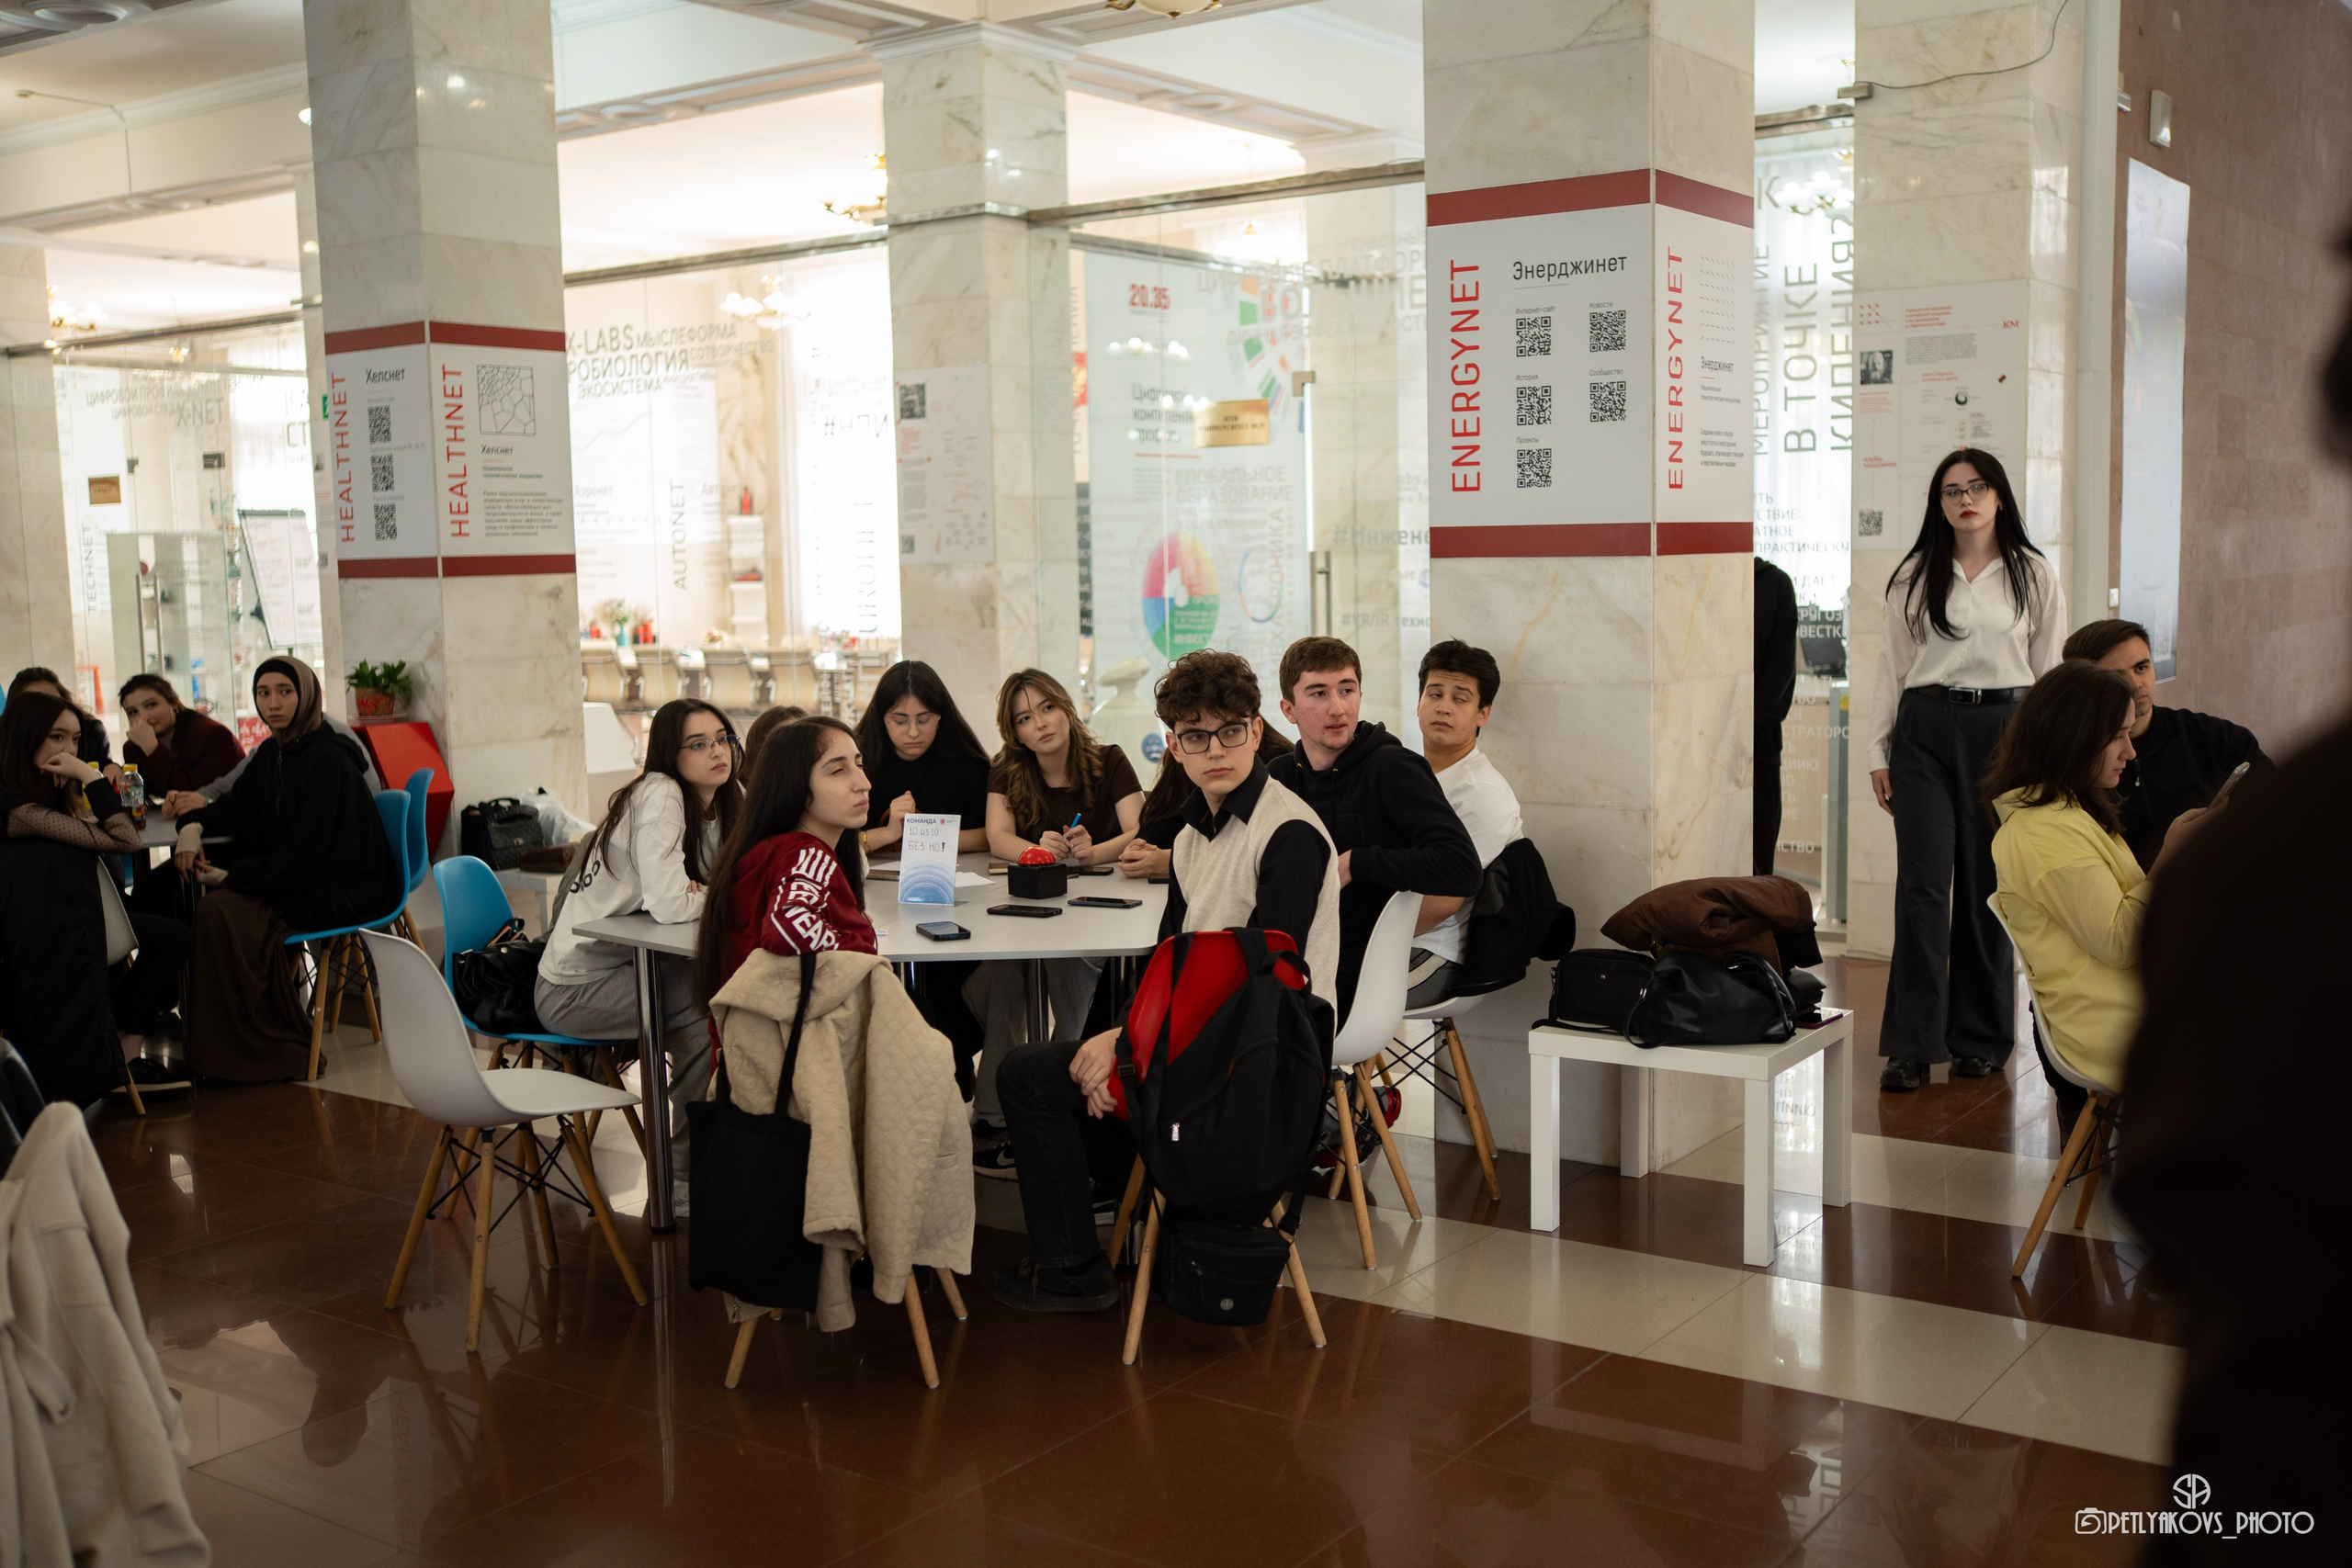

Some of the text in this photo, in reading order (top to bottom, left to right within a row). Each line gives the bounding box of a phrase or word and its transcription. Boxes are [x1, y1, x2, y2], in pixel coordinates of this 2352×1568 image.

[1512, 256, 1627, 282] Энерджинет
[1784, 263, 1817, 412] ТОЧКЕ
[1450, 259, 1480, 492] ENERGYNET
[1668, 245, 1683, 490] ENERGYNET
[331, 371, 356, 543] HEALTHNET
[442, 363, 470, 538] HEALTHNET
[669, 479, 688, 592] AUTONET
[908, 840, 926, 851] БЕЗ
[909, 827, 919, 836] 10
[931, 828, 940, 836] 10
